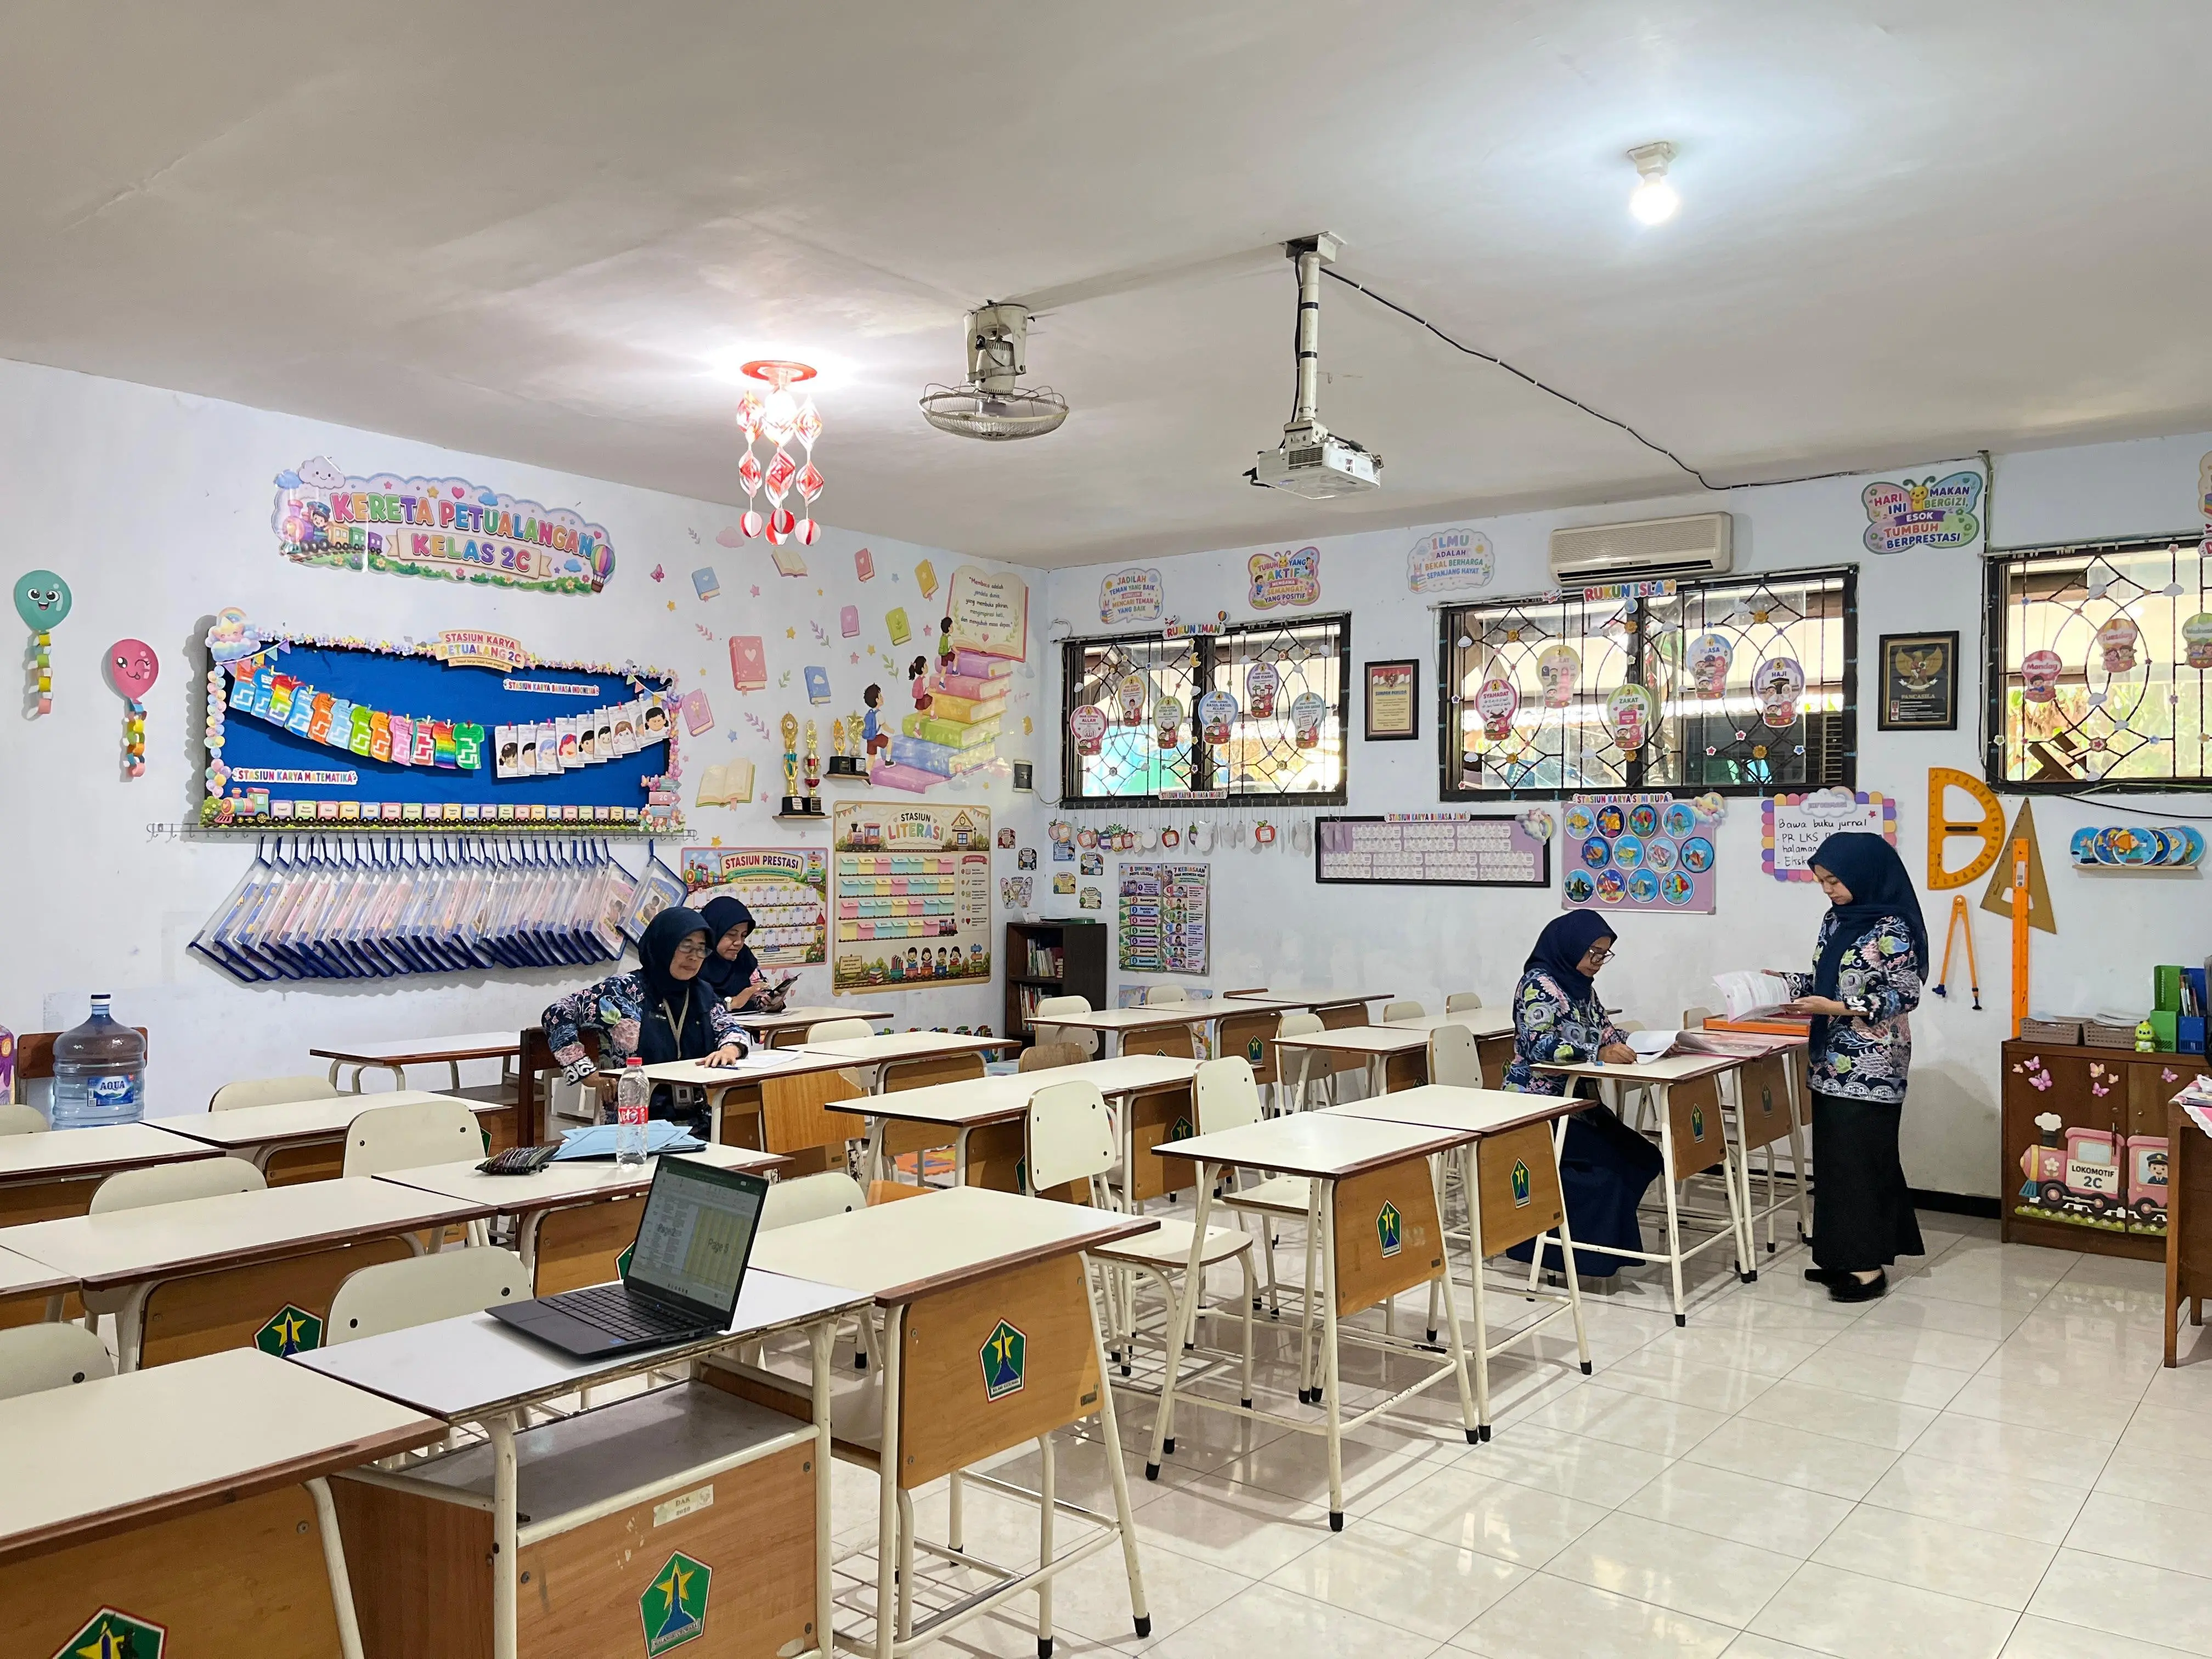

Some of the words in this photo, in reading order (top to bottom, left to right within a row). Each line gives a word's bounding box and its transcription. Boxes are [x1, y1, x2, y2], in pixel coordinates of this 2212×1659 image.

[1930, 487, 1970, 497] MAKAN
[1874, 493, 1903, 507] HARI
[1925, 498, 1968, 509] BERGIZI,
[1888, 503, 1906, 514] INI
[1906, 512, 1933, 522] ESOK
[330, 492, 434, 526] KERETA
[439, 499, 596, 558] PETUALANGAN
[1883, 523, 1939, 538] TUMBUH
[1432, 535, 1469, 550] ILMU
[1887, 533, 1960, 549] BERPRESTASI
[411, 533, 494, 564] KELAS
[501, 545, 531, 573] 2C
[1436, 550, 1466, 558] ADALAH
[1257, 562, 1278, 572] TUBUH
[1425, 561, 1447, 571] BEKAL
[1448, 558, 1483, 567] BERHARGA
[1267, 567, 1300, 580] AKTIF
[1427, 568, 1460, 579] SEPANJANG
[1117, 575, 1146, 585] JADILAH
[1109, 586, 1127, 595] TEMAN
[1268, 586, 1303, 595] SEMANGAT
[1584, 584, 1630, 602] RUKUN
[1634, 579, 1677, 597] ISLAM
[1112, 599, 1135, 608] MENCARI
[1167, 624, 1195, 637] RUKUN
[1198, 624, 1221, 634] IMAN
[2102, 632, 2133, 641] Tuesday
[445, 633, 483, 642] STASIUN
[487, 635, 515, 649] KARYA
[440, 644, 506, 660] PETUALANG
[508, 651, 522, 663] 2C
[509, 681, 531, 690] STASIUN
[533, 682, 550, 691] KARYA
[552, 683, 571, 693] BAHASA
[572, 684, 595, 695] INDONESIA
[238, 770, 274, 780] STASIUN
[277, 771, 302, 781] KARYA
[304, 771, 353, 782] MATEMATIKA
[1577, 795, 1606, 803] STASIUN
[1608, 794, 1631, 803] KARYA
[1633, 794, 1648, 803] SENI
[901, 812, 931, 822] STASIUN
[1779, 819, 1807, 828] Bawa
[1813, 819, 1834, 828] buku
[1838, 819, 1866, 830] jurnal
[888, 822, 944, 840] LITERASI
[1782, 833, 1795, 842] PR
[1800, 832, 1818, 842] LKS
[725, 855, 760, 870] STASIUN
[763, 855, 798, 869] PRESTASI
[100, 1081, 125, 1091] AQUA
[2072, 1164, 2114, 1178] LOKOMOTIF
[2084, 1176, 2103, 1189] 2C
[707, 1238, 723, 1254] Page
[675, 1497, 690, 1507] DAK
